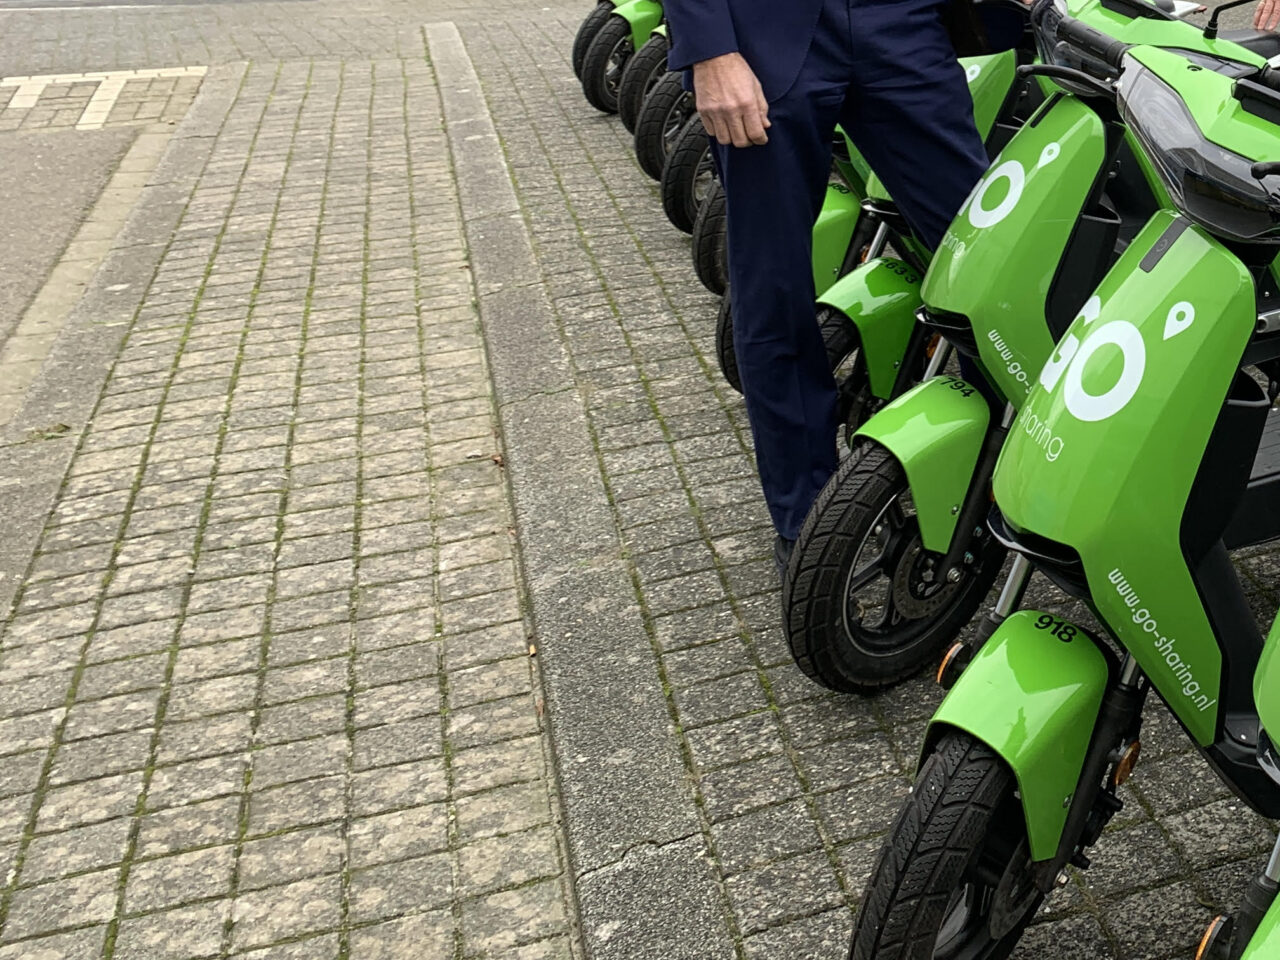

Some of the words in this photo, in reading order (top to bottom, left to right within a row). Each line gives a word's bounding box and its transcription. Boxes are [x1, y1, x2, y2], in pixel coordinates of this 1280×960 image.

[957, 152, 1026, 229] O
[940, 377, 975, 398] 794
[1039, 295, 1147, 422] GO
[1034, 614, 1078, 643] 918
[1107, 567, 1218, 712] www.go-sharing.nl
